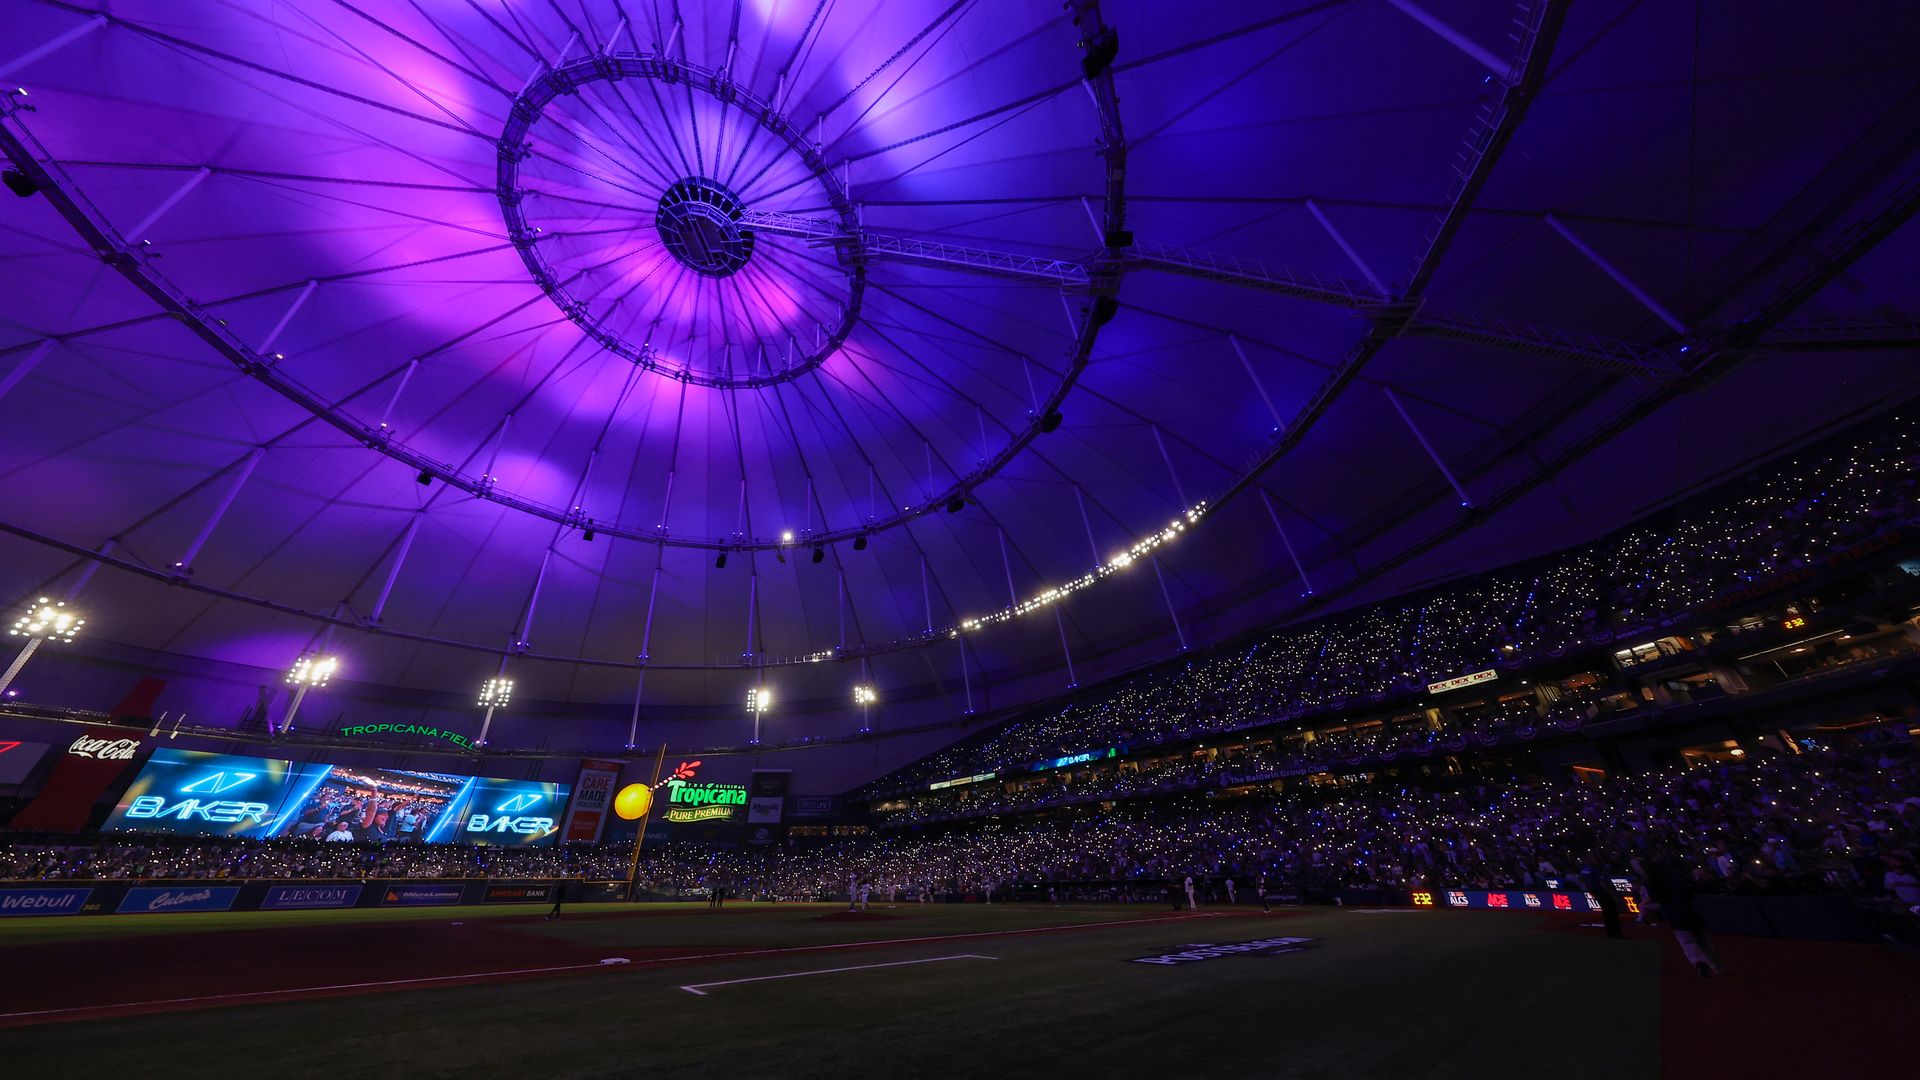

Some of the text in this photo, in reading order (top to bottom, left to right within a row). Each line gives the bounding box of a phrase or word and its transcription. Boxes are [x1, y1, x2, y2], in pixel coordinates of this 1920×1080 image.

[1430, 672, 1492, 690] DEX DEX DEX
[340, 723, 437, 737] TROPICANA
[68, 734, 141, 760] Coca-Cola
[1231, 764, 1329, 784] The Baldwin Group Club
[583, 776, 611, 790] CARE
[578, 790, 608, 802] MADE
[667, 780, 748, 806] Tropicana
[126, 796, 268, 823] BAKER
[669, 807, 734, 820] PURE PREMIUM
[467, 814, 553, 834] BAKER
[148, 888, 211, 911] Culver's
[279, 890, 348, 901] LECOM
[526, 889, 546, 897] BANK
[1487, 893, 1509, 905] ACE
[1552, 893, 1572, 907] ACE
[2, 894, 76, 909] Webull
[1450, 896, 1469, 905] ALCS
[1525, 897, 1541, 905] ALCS
